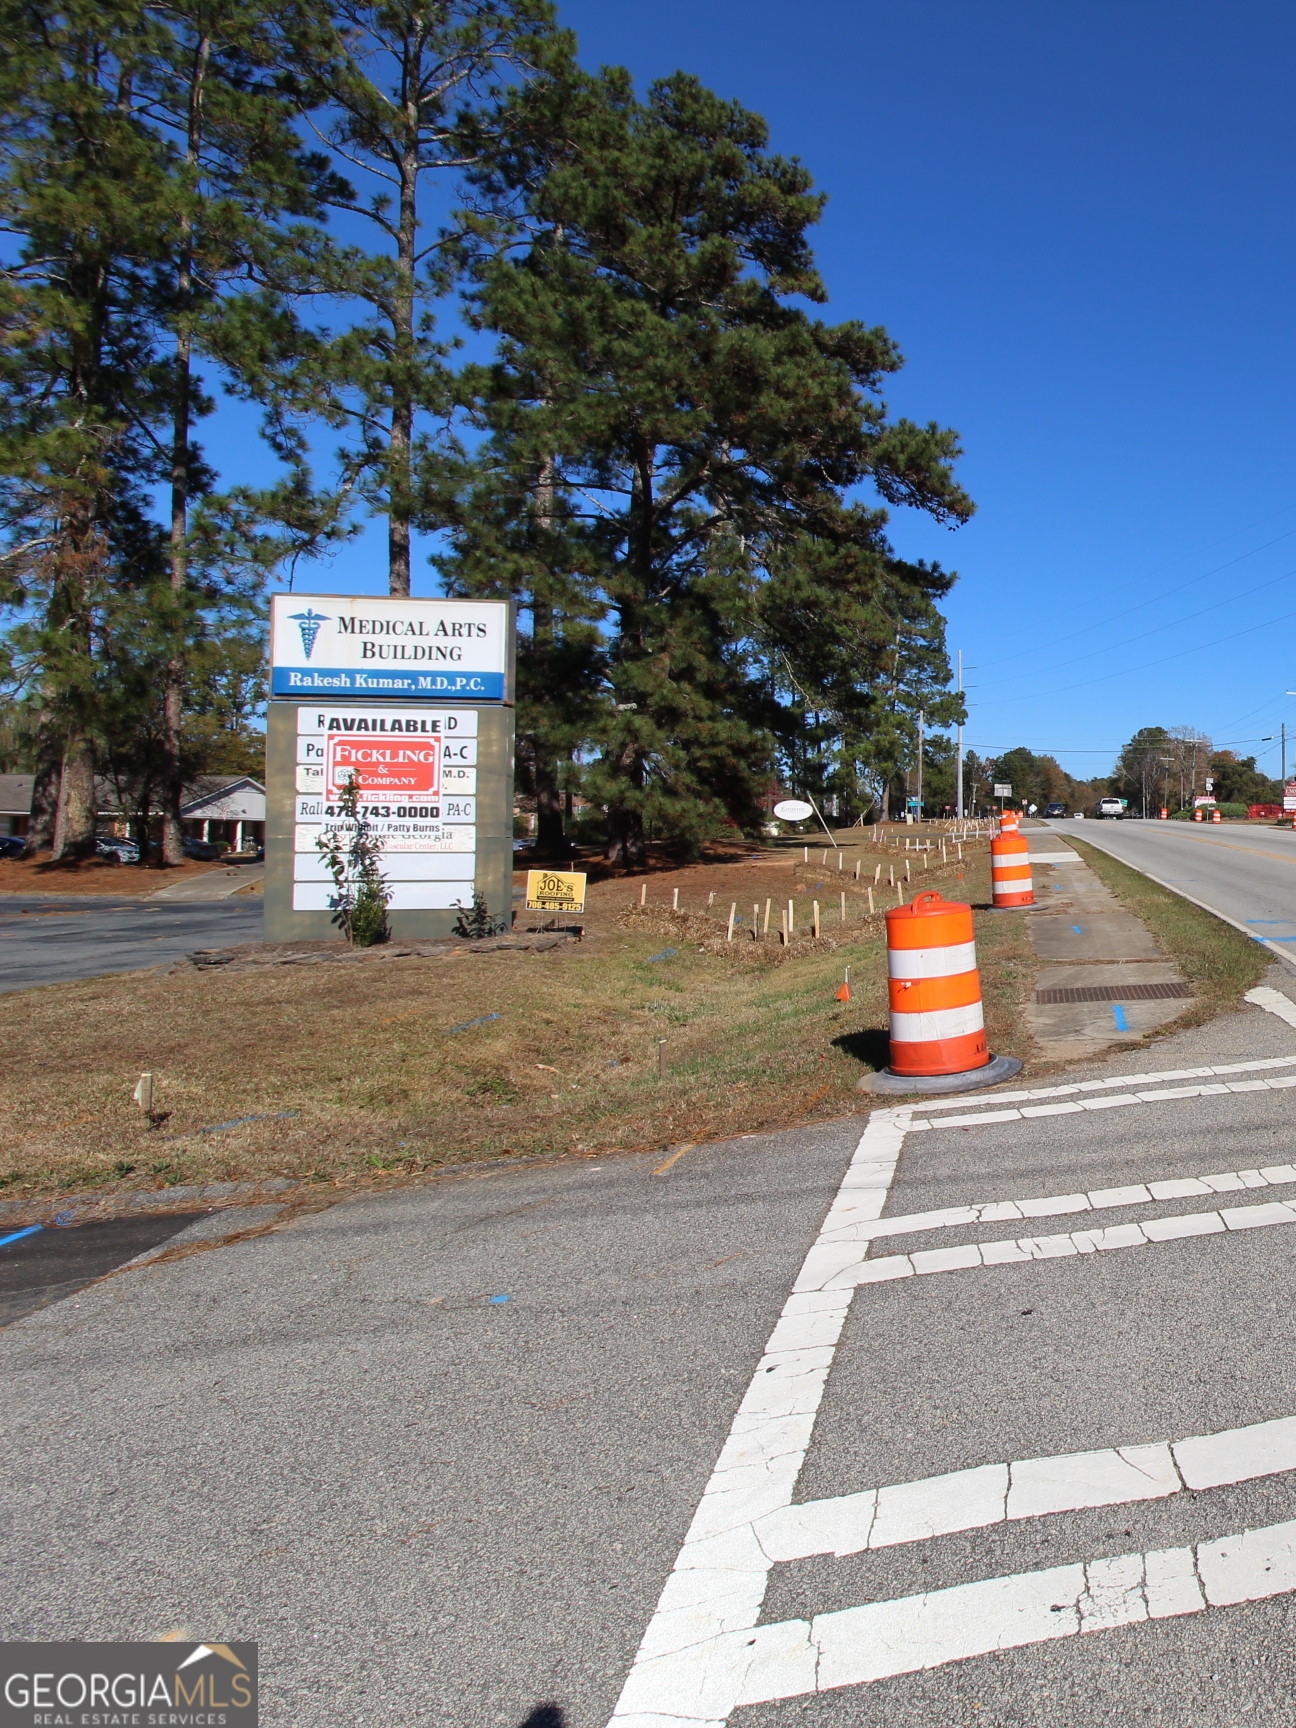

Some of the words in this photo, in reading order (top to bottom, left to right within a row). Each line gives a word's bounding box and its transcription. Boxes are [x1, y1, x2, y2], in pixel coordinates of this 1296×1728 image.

[337, 616, 430, 636] MEDICAL
[434, 619, 487, 638] ARTS
[360, 641, 463, 662] BUILDING
[289, 672, 350, 687] Rakesh
[354, 673, 416, 691] Kumar,
[327, 717, 442, 733] AVAILABLE
[334, 745, 434, 763] FICKLING
[358, 774, 417, 786] COMPANY
[387, 823, 411, 833] Patty
[412, 823, 440, 833] Burns
